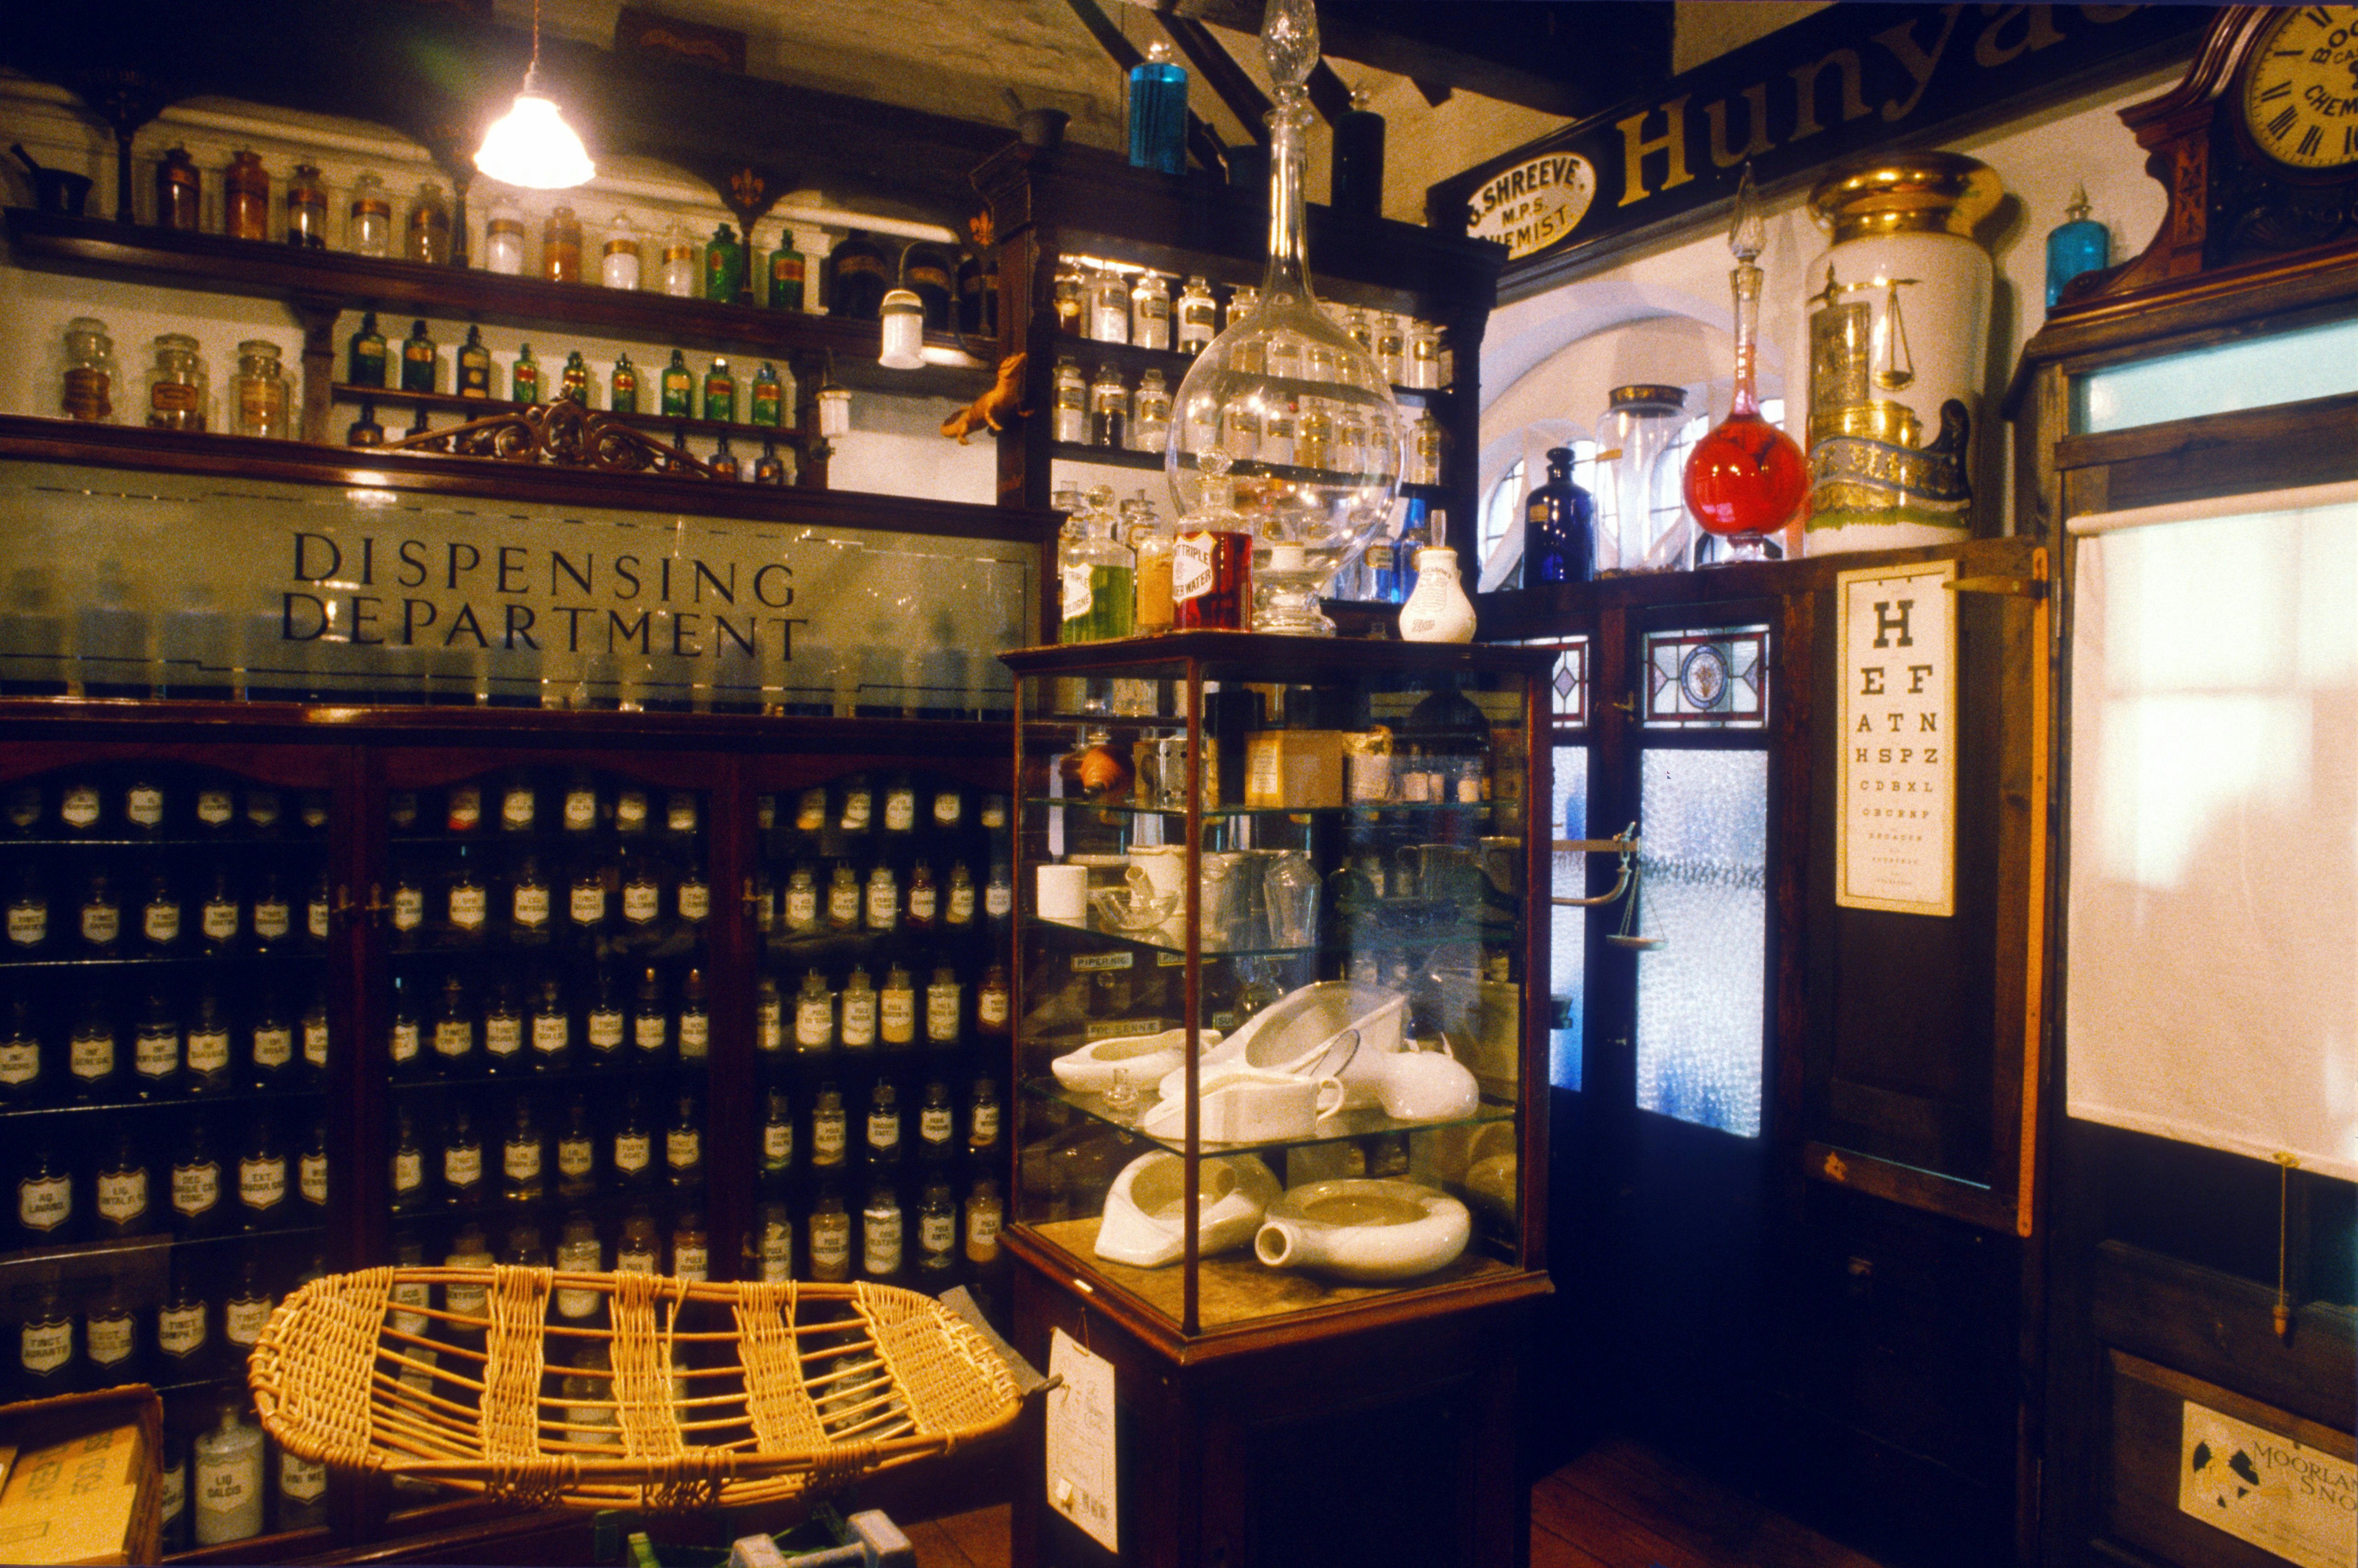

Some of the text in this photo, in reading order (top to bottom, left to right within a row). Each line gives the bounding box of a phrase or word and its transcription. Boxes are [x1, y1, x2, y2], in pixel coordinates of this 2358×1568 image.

[2334, 50, 2358, 64] CA
[1616, 4, 2147, 207] Hunya
[1181, 544, 1209, 564] TRIPLE
[293, 532, 794, 608] DISPENSING
[1185, 571, 1211, 593] WATER
[282, 593, 808, 661] DEPARTMENT
[1873, 600, 1914, 648] H
[1078, 957, 1107, 966] PIPER
[253, 1173, 271, 1182] EXT
